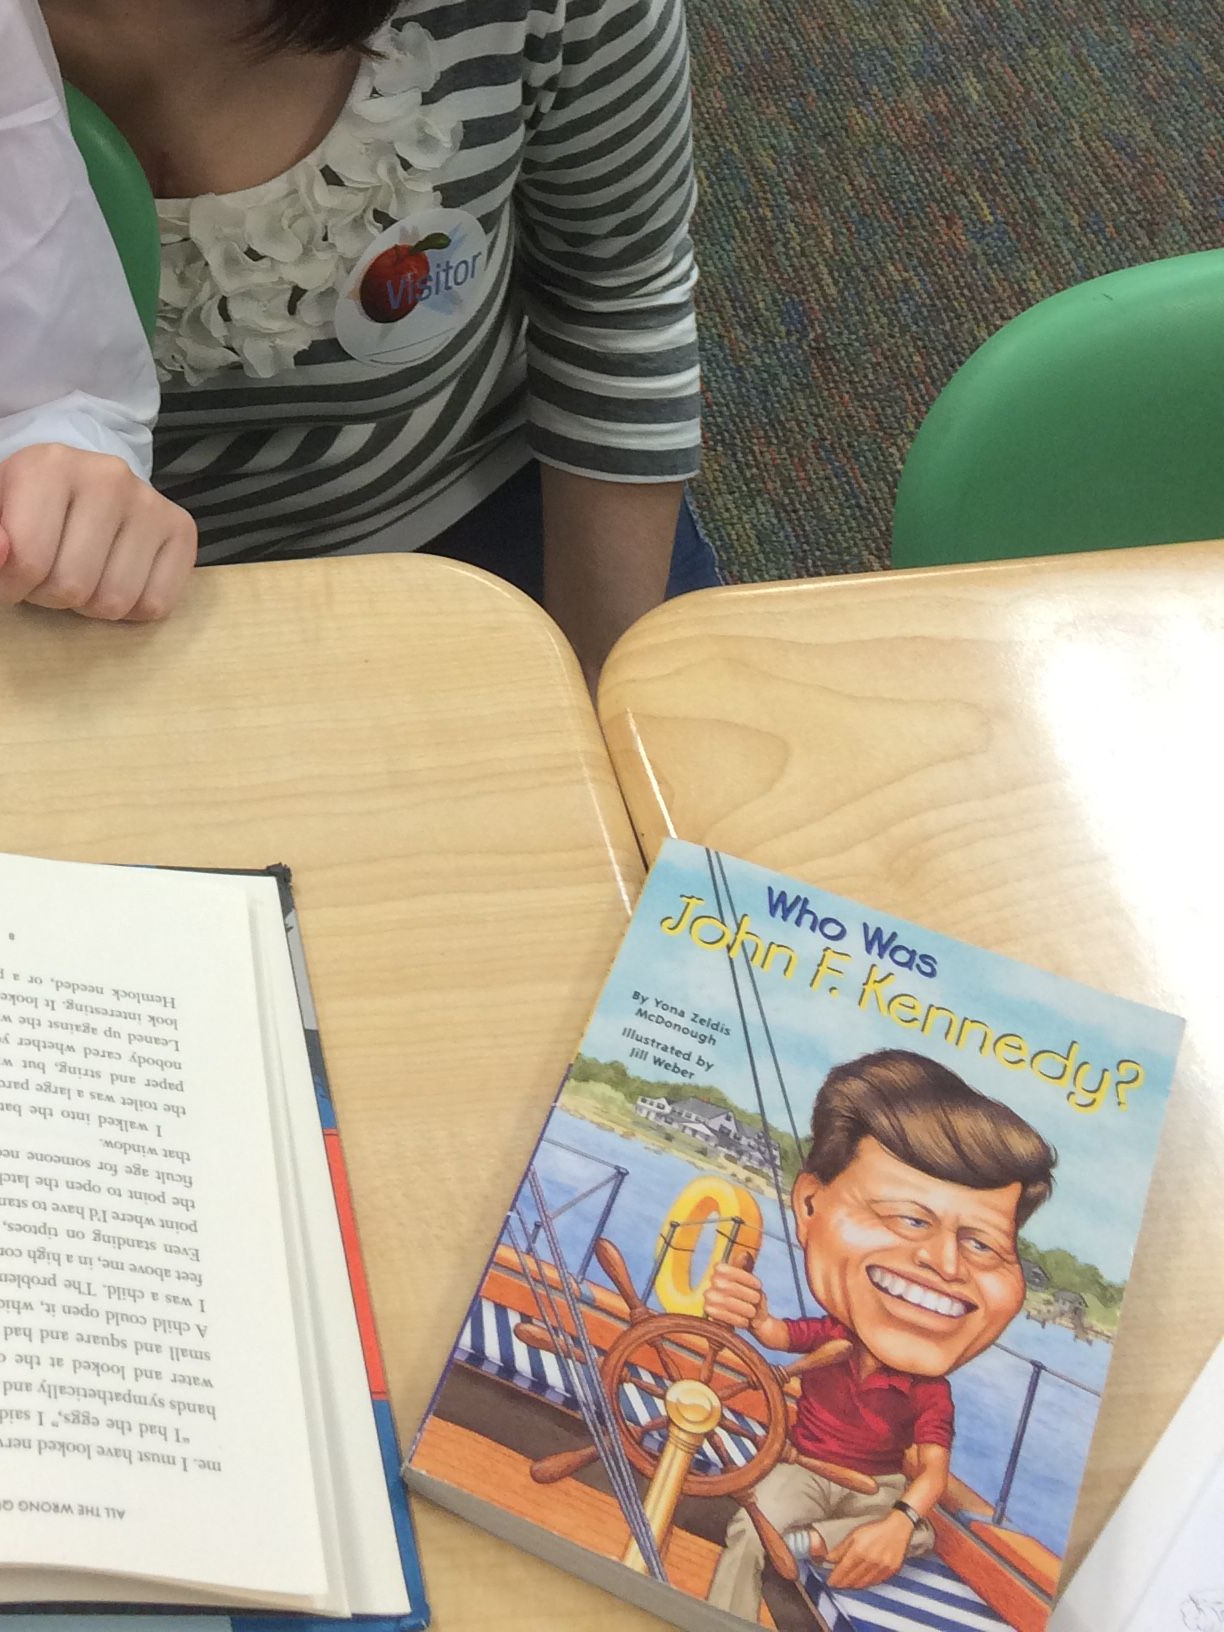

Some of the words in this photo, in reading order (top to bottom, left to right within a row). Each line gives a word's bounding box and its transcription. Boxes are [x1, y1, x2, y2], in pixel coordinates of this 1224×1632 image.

[386, 251, 482, 310] Visitor
[767, 885, 847, 942] Who
[862, 921, 938, 979] Was
[26, 974, 45, 986] or
[48, 976, 106, 996] needed,
[110, 987, 178, 1011] Hemlock
[660, 894, 798, 979] John
[809, 947, 852, 998] F.
[858, 963, 1144, 1113] Kennedy?
[632, 990, 649, 1004] By
[654, 998, 685, 1018] Yona
[690, 1013, 731, 1036] Zeldis
[635, 1008, 717, 1046] McDonough
[622, 1027, 692, 1061] Illustrated
[696, 1055, 714, 1072] by
[629, 1047, 649, 1061] Jill
[652, 1055, 695, 1079] Weber
[98, 1138, 159, 1158] window.
[161, 1147, 192, 1165] that
[105, 1417, 133, 1437] the
[137, 1421, 169, 1443] had
[36, 1439, 92, 1461] looked
[95, 1444, 133, 1465] have
[136, 1449, 177, 1467] must
[193, 1458, 223, 1473] me.
[17, 1499, 75, 1515] WRONG
[77, 1503, 102, 1519] THE
[103, 1506, 126, 1521] ALL
